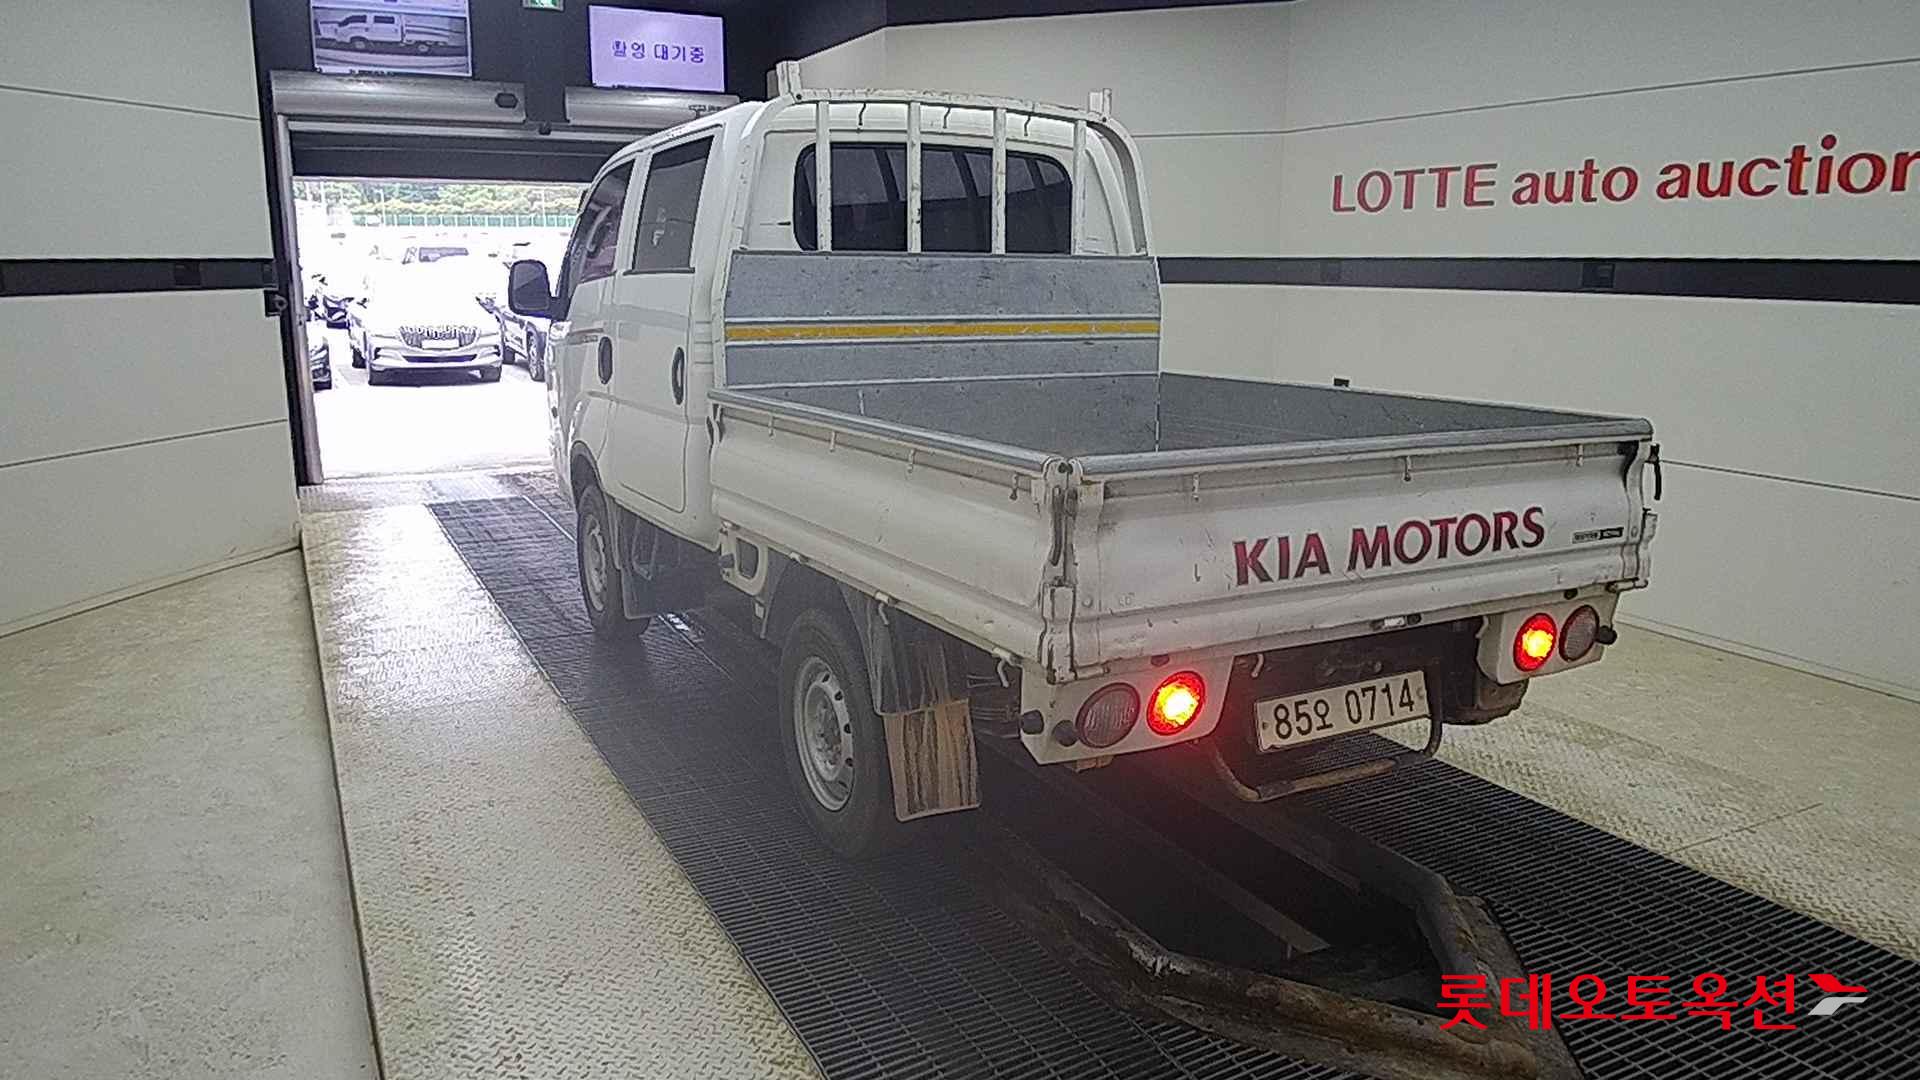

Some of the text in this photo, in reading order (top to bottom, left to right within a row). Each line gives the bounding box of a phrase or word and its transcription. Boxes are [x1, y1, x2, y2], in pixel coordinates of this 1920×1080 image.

[654, 44, 704, 63] 대기중
[1332, 162, 1498, 212] LOTTE
[1511, 159, 1639, 205] auto
[1233, 506, 1545, 586] KIA MOTORS
[1273, 678, 1415, 740] 85오 0714
